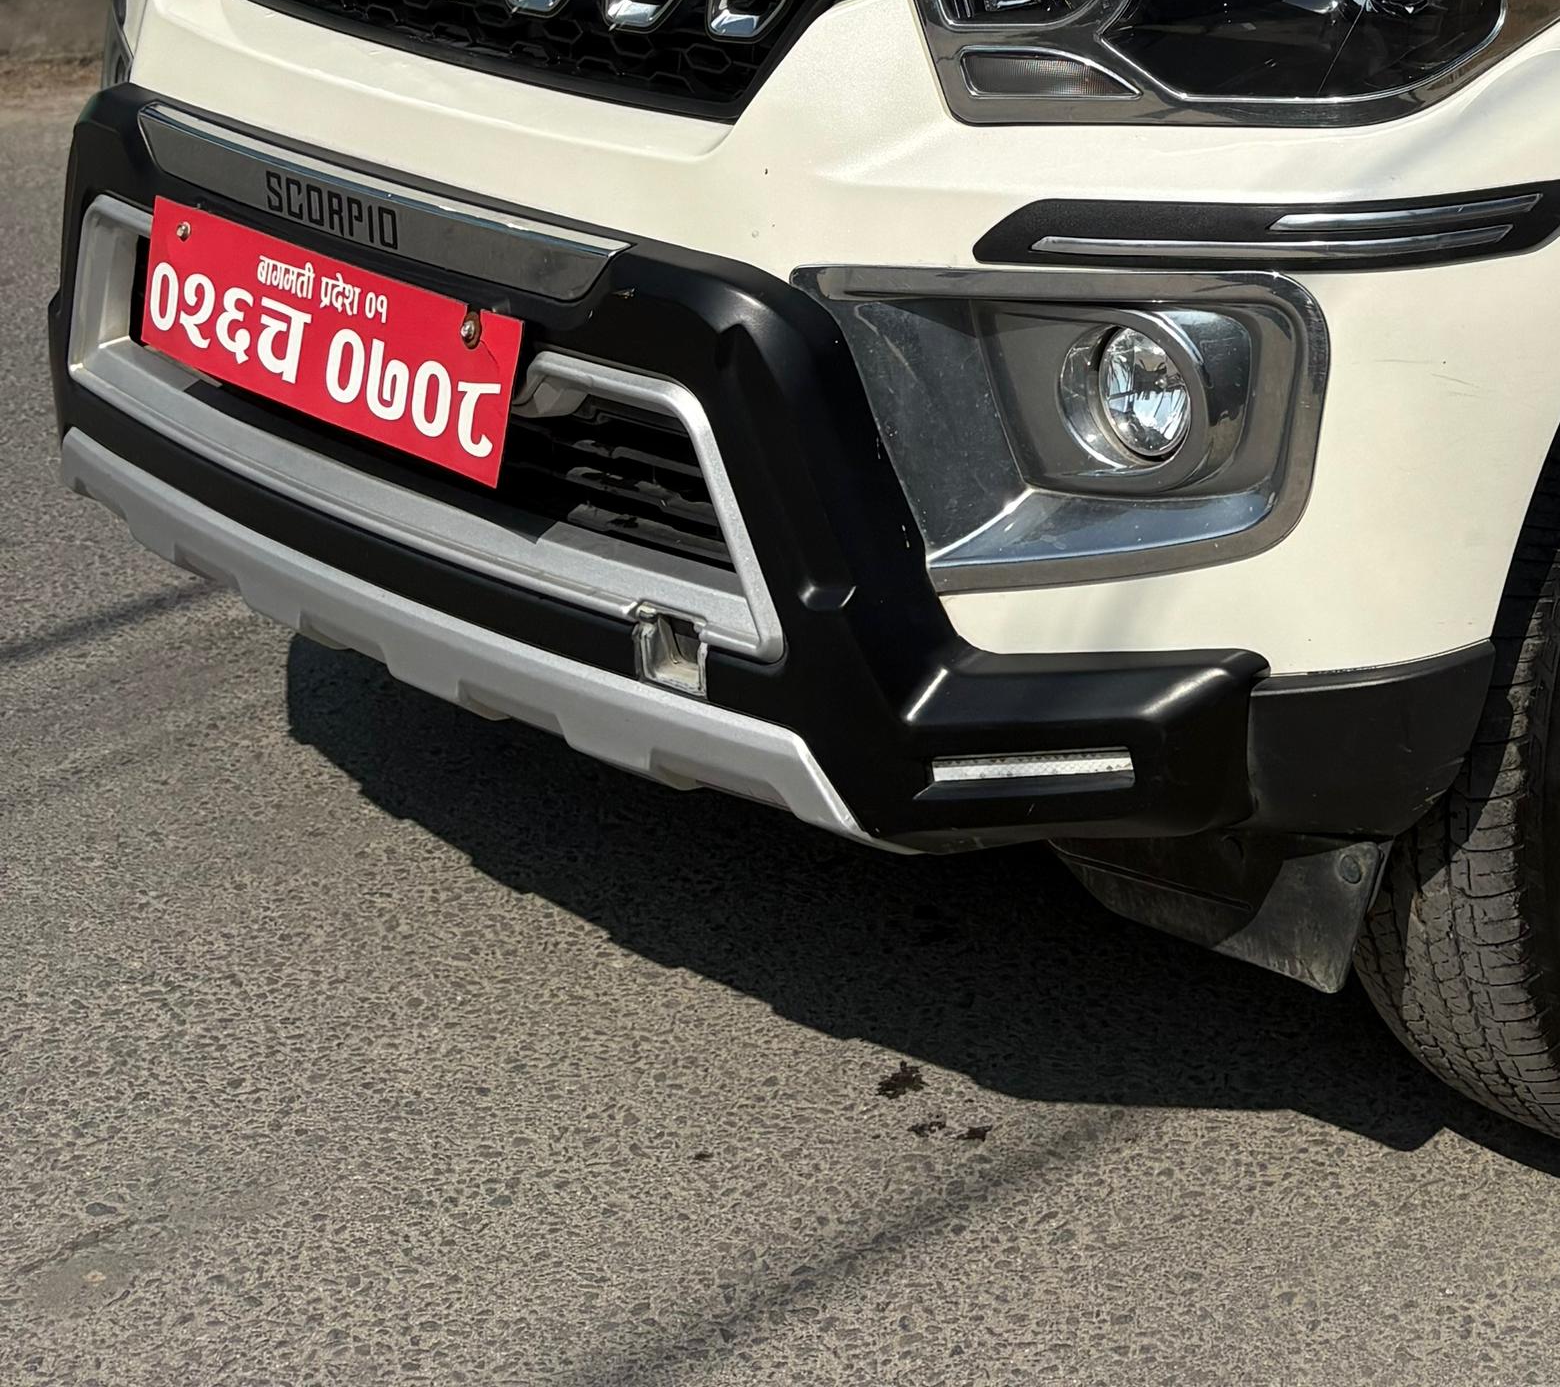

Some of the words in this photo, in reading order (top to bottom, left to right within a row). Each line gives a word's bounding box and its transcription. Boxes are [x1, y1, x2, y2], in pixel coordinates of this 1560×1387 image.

[265, 170, 398, 250] SCORPIO
[257, 255, 314, 300] बागमती
[320, 272, 362, 316] प्रदेश
[364, 291, 389, 324] ०१
[149, 261, 312, 384] ०२६च
[325, 328, 502, 458] ०७०८
